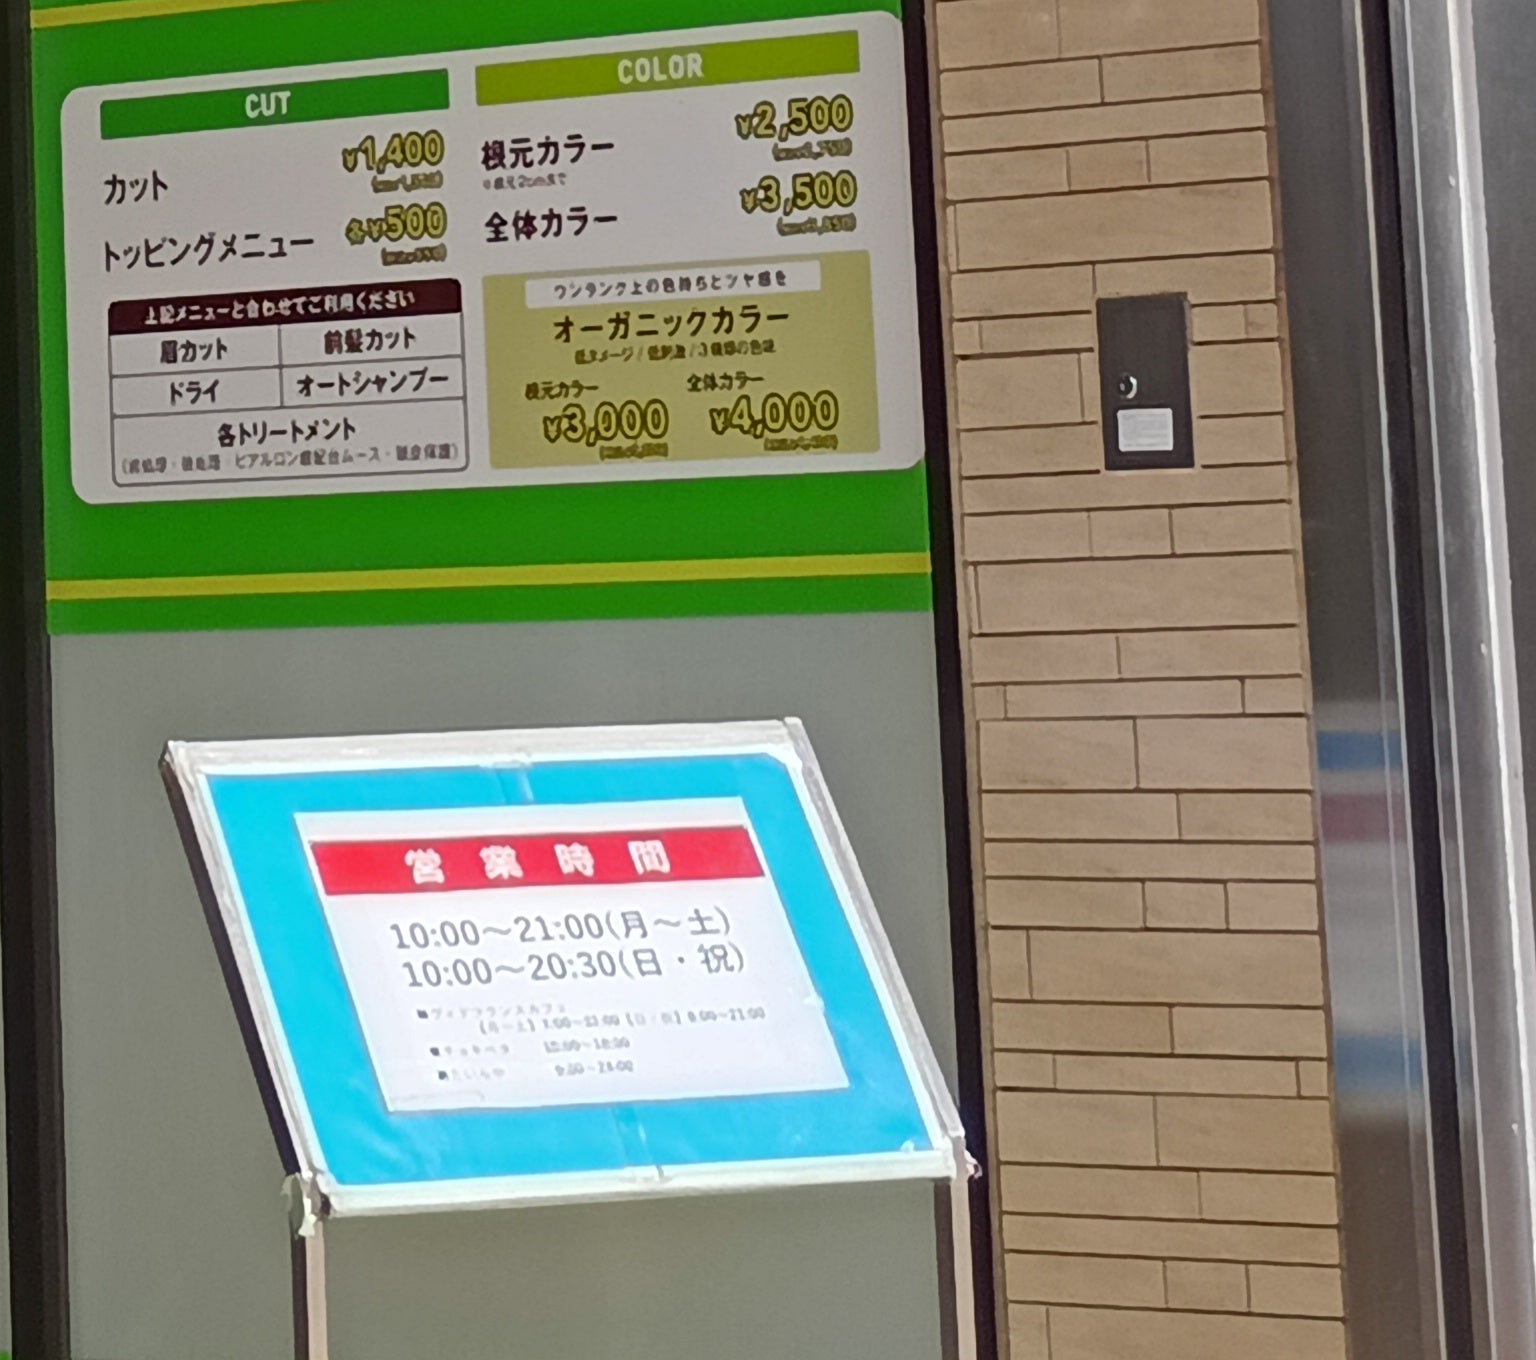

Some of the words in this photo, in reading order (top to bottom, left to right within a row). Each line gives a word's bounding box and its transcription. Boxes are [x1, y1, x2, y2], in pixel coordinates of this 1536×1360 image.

[617, 52, 703, 84] COLOR
[245, 90, 291, 119] CUT
[481, 133, 615, 171] 根元カラー
[735, 94, 854, 142] ¥2,500
[104, 170, 168, 207] カット
[342, 130, 445, 174] ¥1,400
[485, 205, 618, 243] 全体カラー
[740, 169, 858, 216] ¥3,500
[104, 231, 314, 272] トッピングメニュー
[324, 327, 416, 356] 前髪カット
[554, 303, 790, 343] オーガニックカラー
[169, 378, 220, 405] ドライ
[296, 367, 449, 398] オートシャンプー
[686, 371, 765, 394] 全体カラー
[217, 418, 356, 447] 各トリートメント
[543, 398, 669, 445] ¥3,000
[710, 390, 839, 440] ¥4,000
[404, 839, 672, 885] 営業時間
